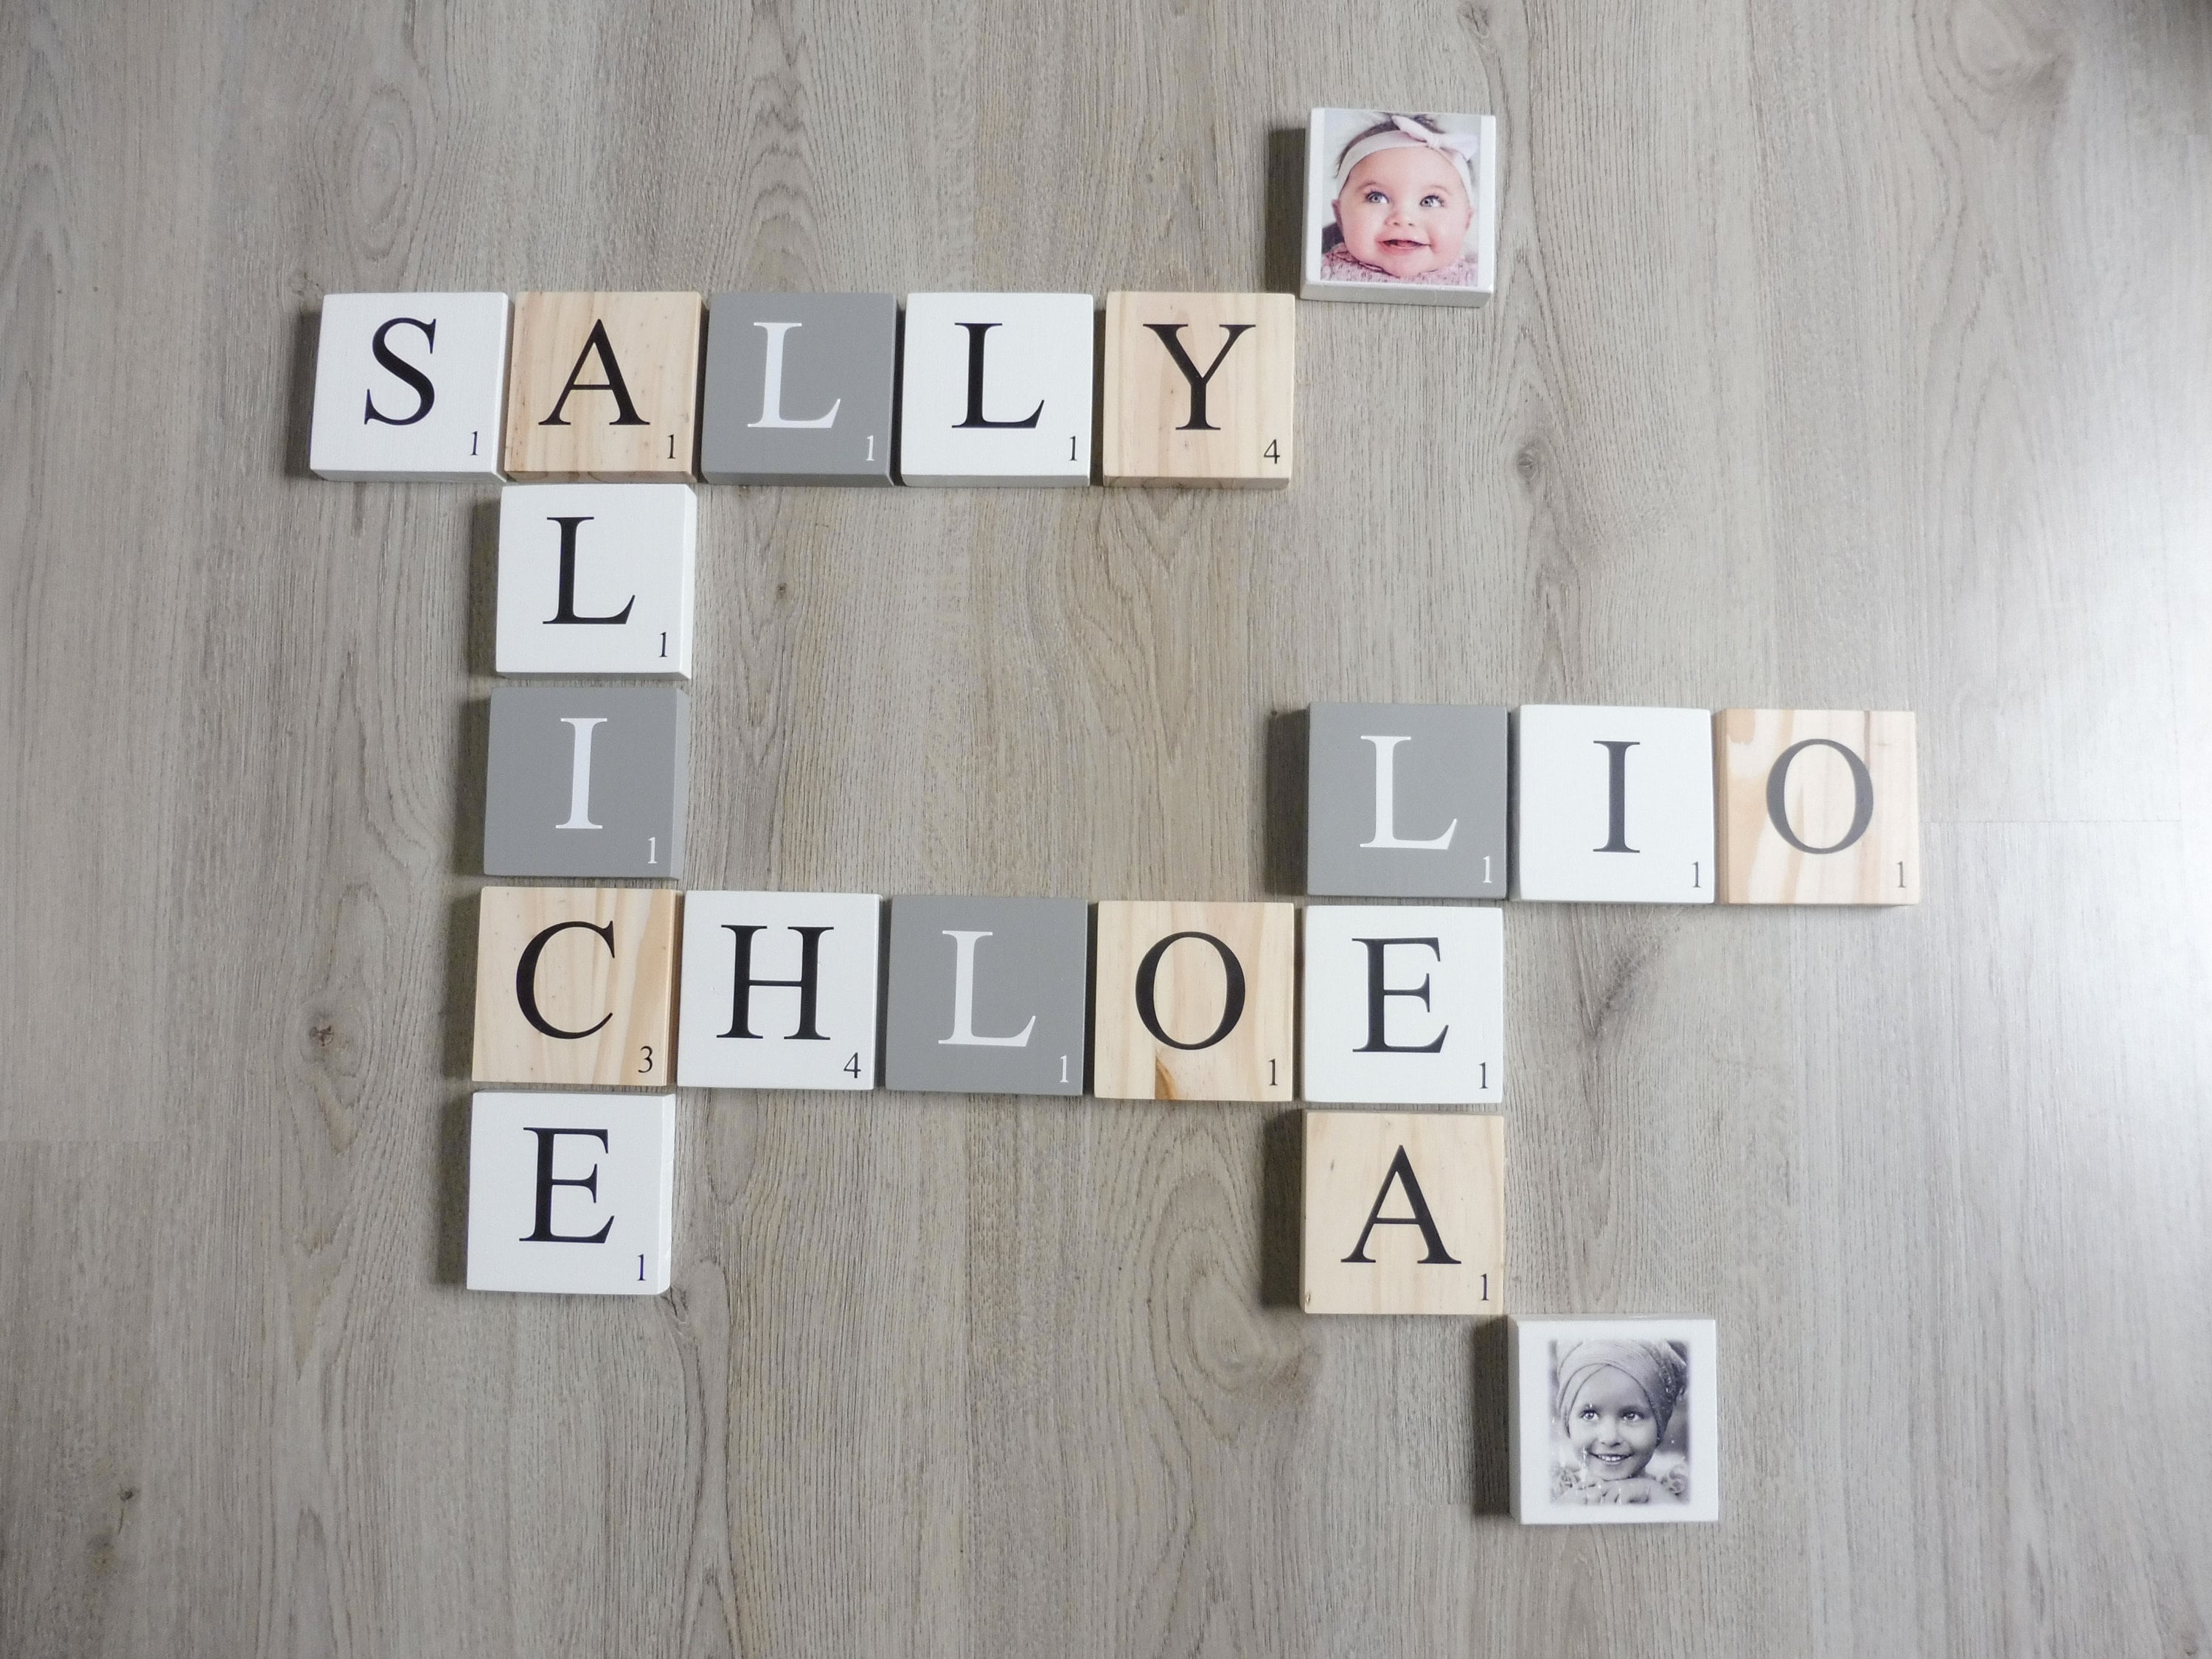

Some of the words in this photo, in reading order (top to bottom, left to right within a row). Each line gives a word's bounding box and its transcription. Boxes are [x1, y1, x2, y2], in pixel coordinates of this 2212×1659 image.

[470, 430, 479, 456] 1
[667, 433, 677, 460] 1
[865, 434, 875, 462] 1
[1068, 435, 1079, 462] 1
[1262, 438, 1282, 465] 4
[658, 630, 669, 658] 1
[646, 835, 658, 865] 1
[1481, 855, 1493, 884] 1
[1691, 860, 1703, 889] 1
[1896, 860, 1907, 890] 1
[636, 1045, 655, 1074] 3
[842, 1051, 863, 1079] 4
[1059, 1054, 1070, 1084] 1
[1267, 1057, 1279, 1087] 1
[1478, 1061, 1489, 1090] 1
[636, 1253, 647, 1282] 1
[1479, 1273, 1490, 1302] 1
